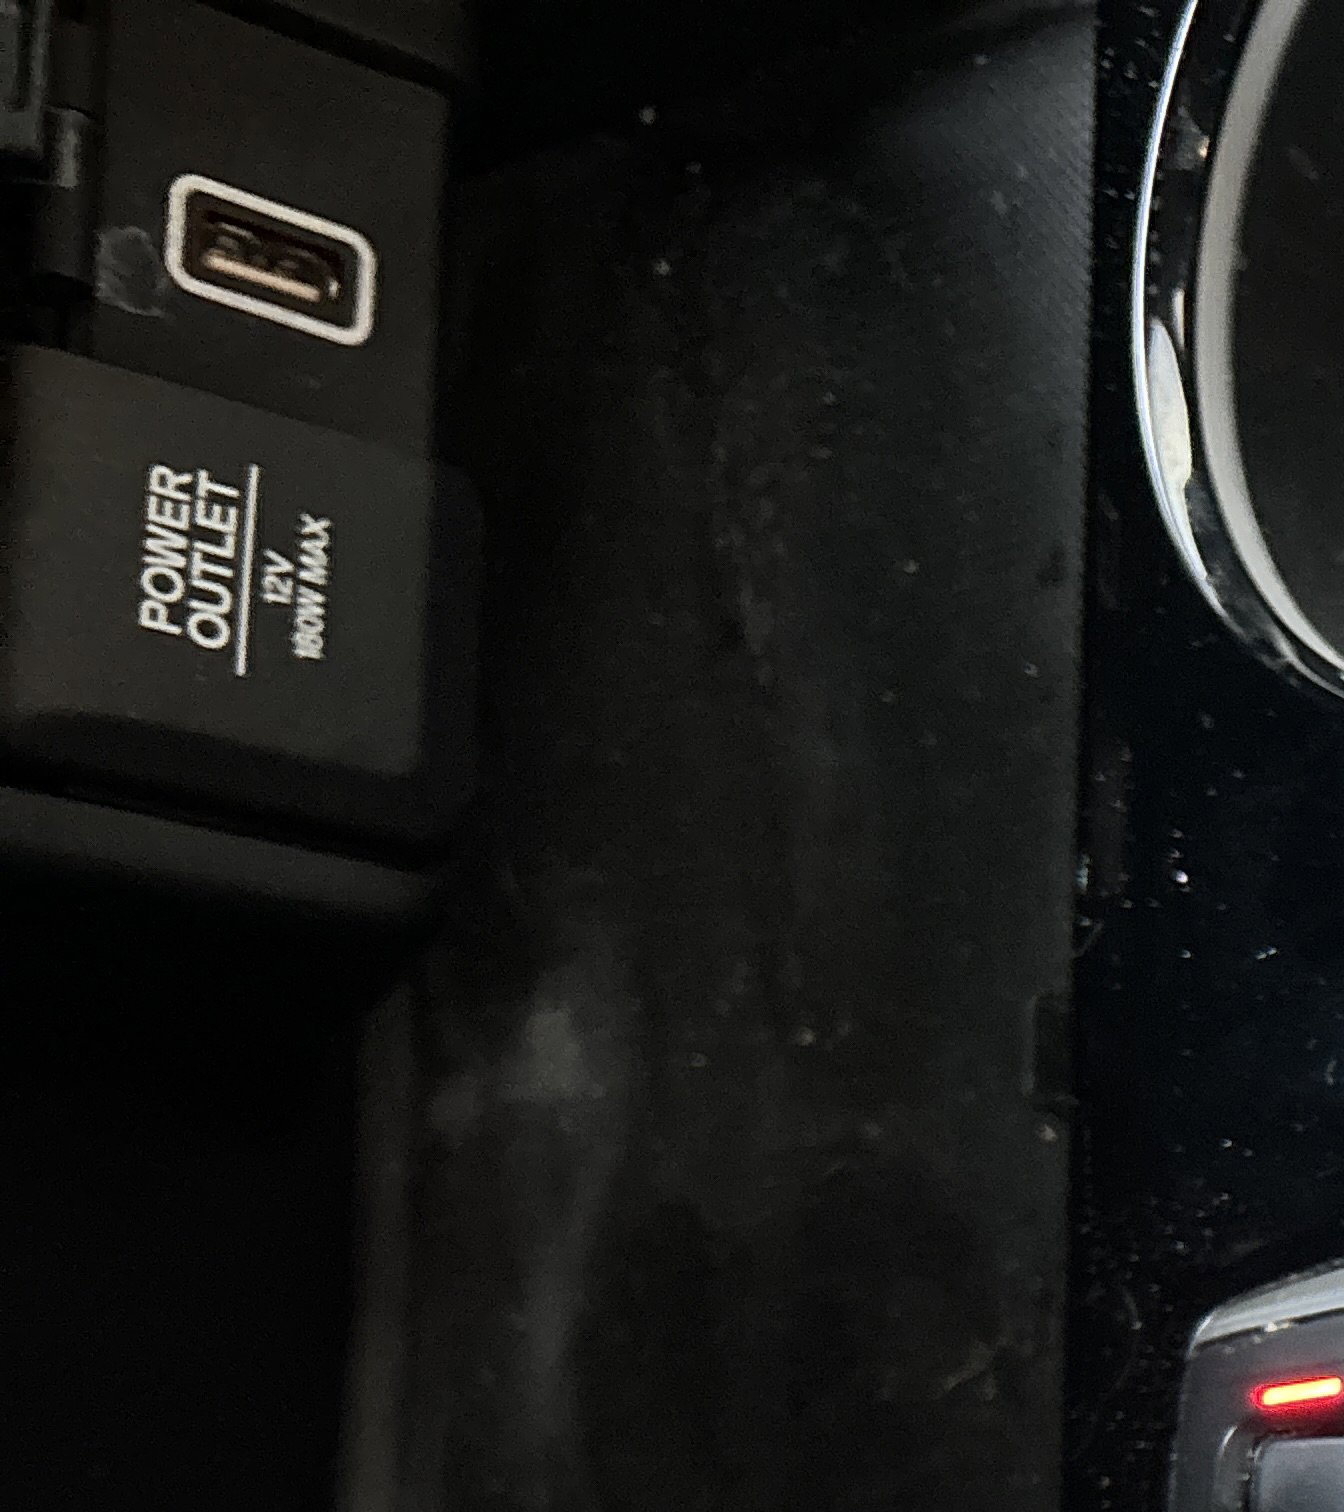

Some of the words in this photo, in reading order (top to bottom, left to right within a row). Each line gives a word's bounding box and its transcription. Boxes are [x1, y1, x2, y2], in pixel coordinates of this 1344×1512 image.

[137, 464, 193, 636] POWER
[186, 468, 241, 650] OUTLET
[262, 549, 296, 605] 12V
[299, 512, 333, 588] MAX
